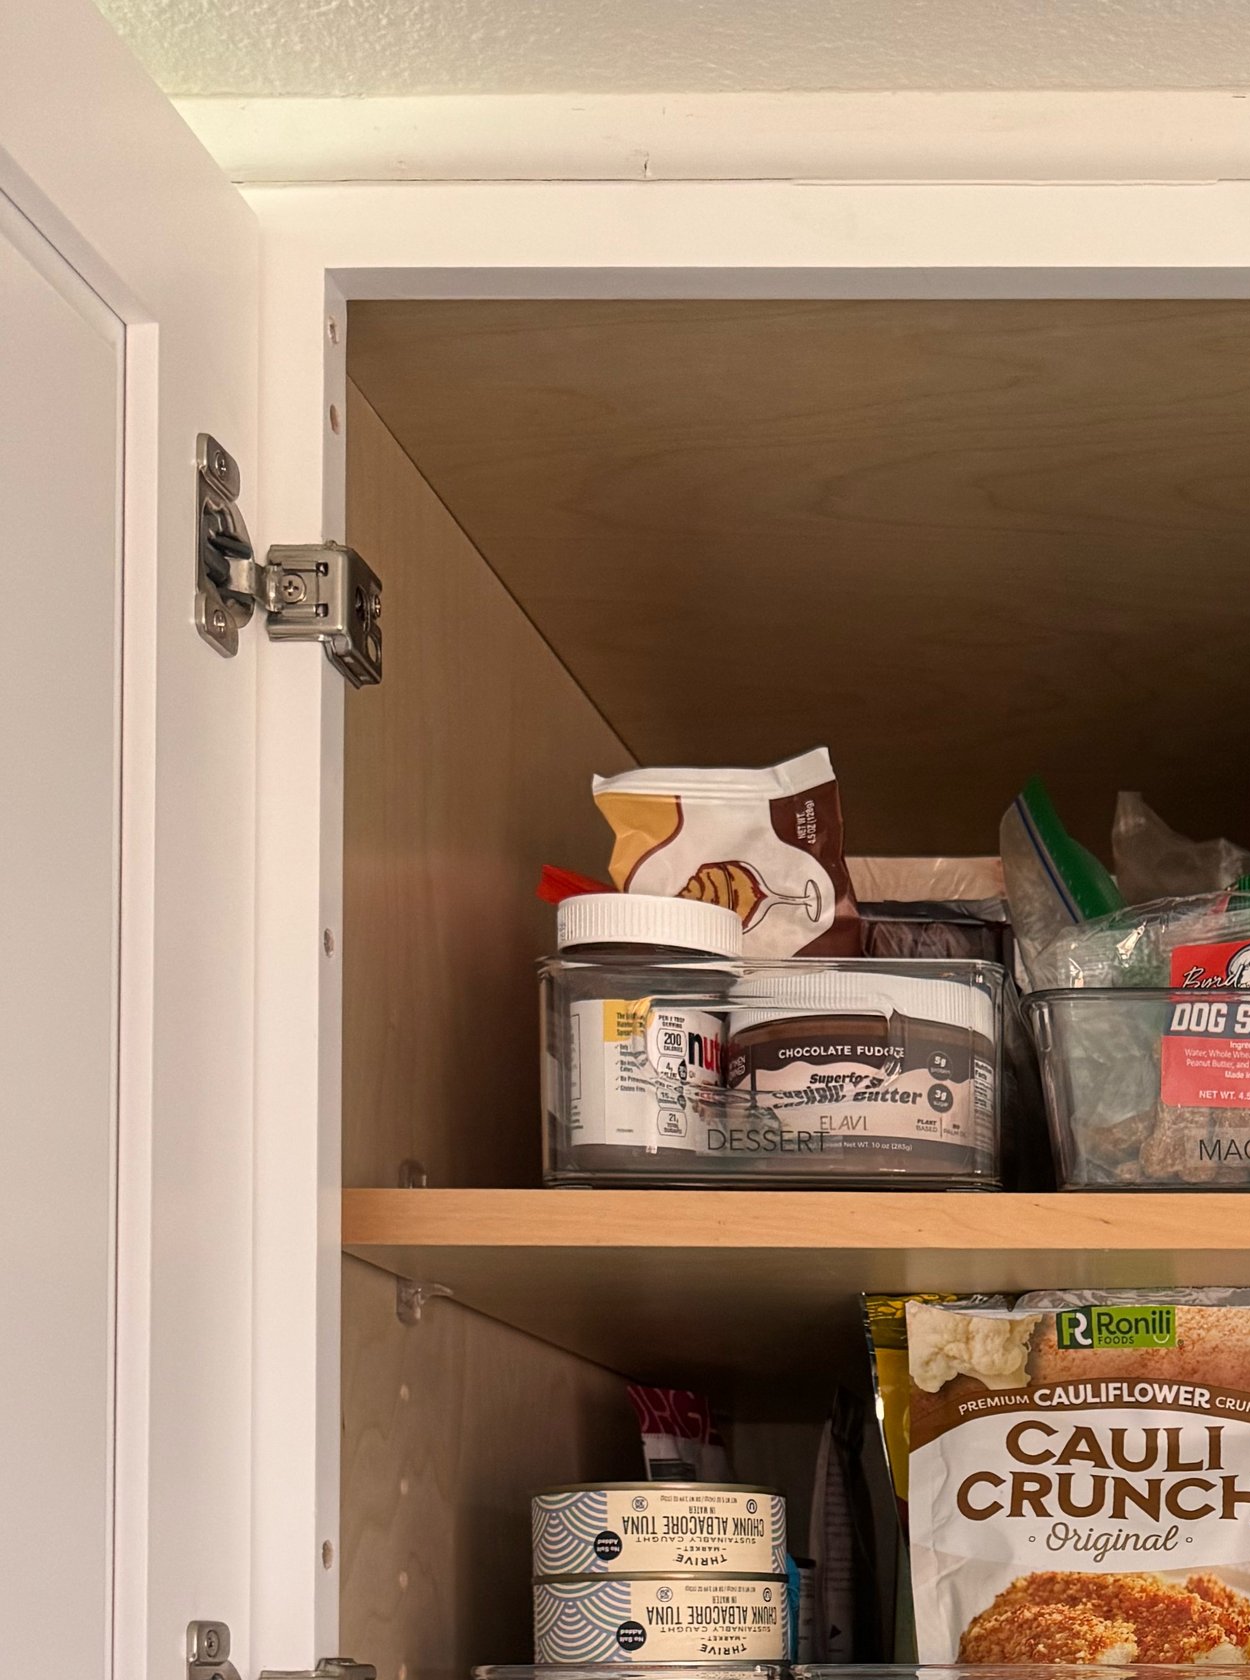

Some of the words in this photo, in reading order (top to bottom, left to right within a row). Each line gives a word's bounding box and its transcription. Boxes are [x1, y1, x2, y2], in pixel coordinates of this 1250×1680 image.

[1170, 1002, 1228, 1033] DOG
[664, 1032, 682, 1046] 200
[778, 1045, 852, 1059] CHOCOLATE
[1185, 1049, 1207, 1058] Water,
[1208, 1049, 1231, 1058] Whole
[934, 1056, 947, 1067] 5g
[1186, 1058, 1211, 1067] Peanut
[1212, 1060, 1235, 1069] Butter,
[935, 1089, 947, 1101] 3g
[1199, 1090, 1217, 1099] NET
[1220, 1091, 1236, 1099] WT.
[819, 1115, 869, 1131] ELAVI
[707, 1130, 830, 1153] DESSERT
[1097, 1309, 1172, 1335] Ronili
[1098, 1336, 1135, 1345] FOODS
[958, 1394, 1030, 1416] PREMIUM
[1033, 1382, 1211, 1409] CAULIFLOWER
[1005, 1419, 1225, 1472] CAULI
[688, 1505, 708, 1514] WATER
[709, 1506, 716, 1514] IN
[622, 1515, 658, 1535] TUNA
[663, 1515, 728, 1536] ALBACORE
[732, 1517, 764, 1537] CHUNK
[689, 1536, 757, 1544] SUSTAINABLY
[1045, 1521, 1179, 1563] Original
[675, 1553, 728, 1566] THRIVE
[646, 1606, 681, 1625] TUNA
[687, 1605, 748, 1625] ALBACORE
[751, 1606, 777, 1625] CHUNK
[700, 1643, 748, 1655] THRIVE
